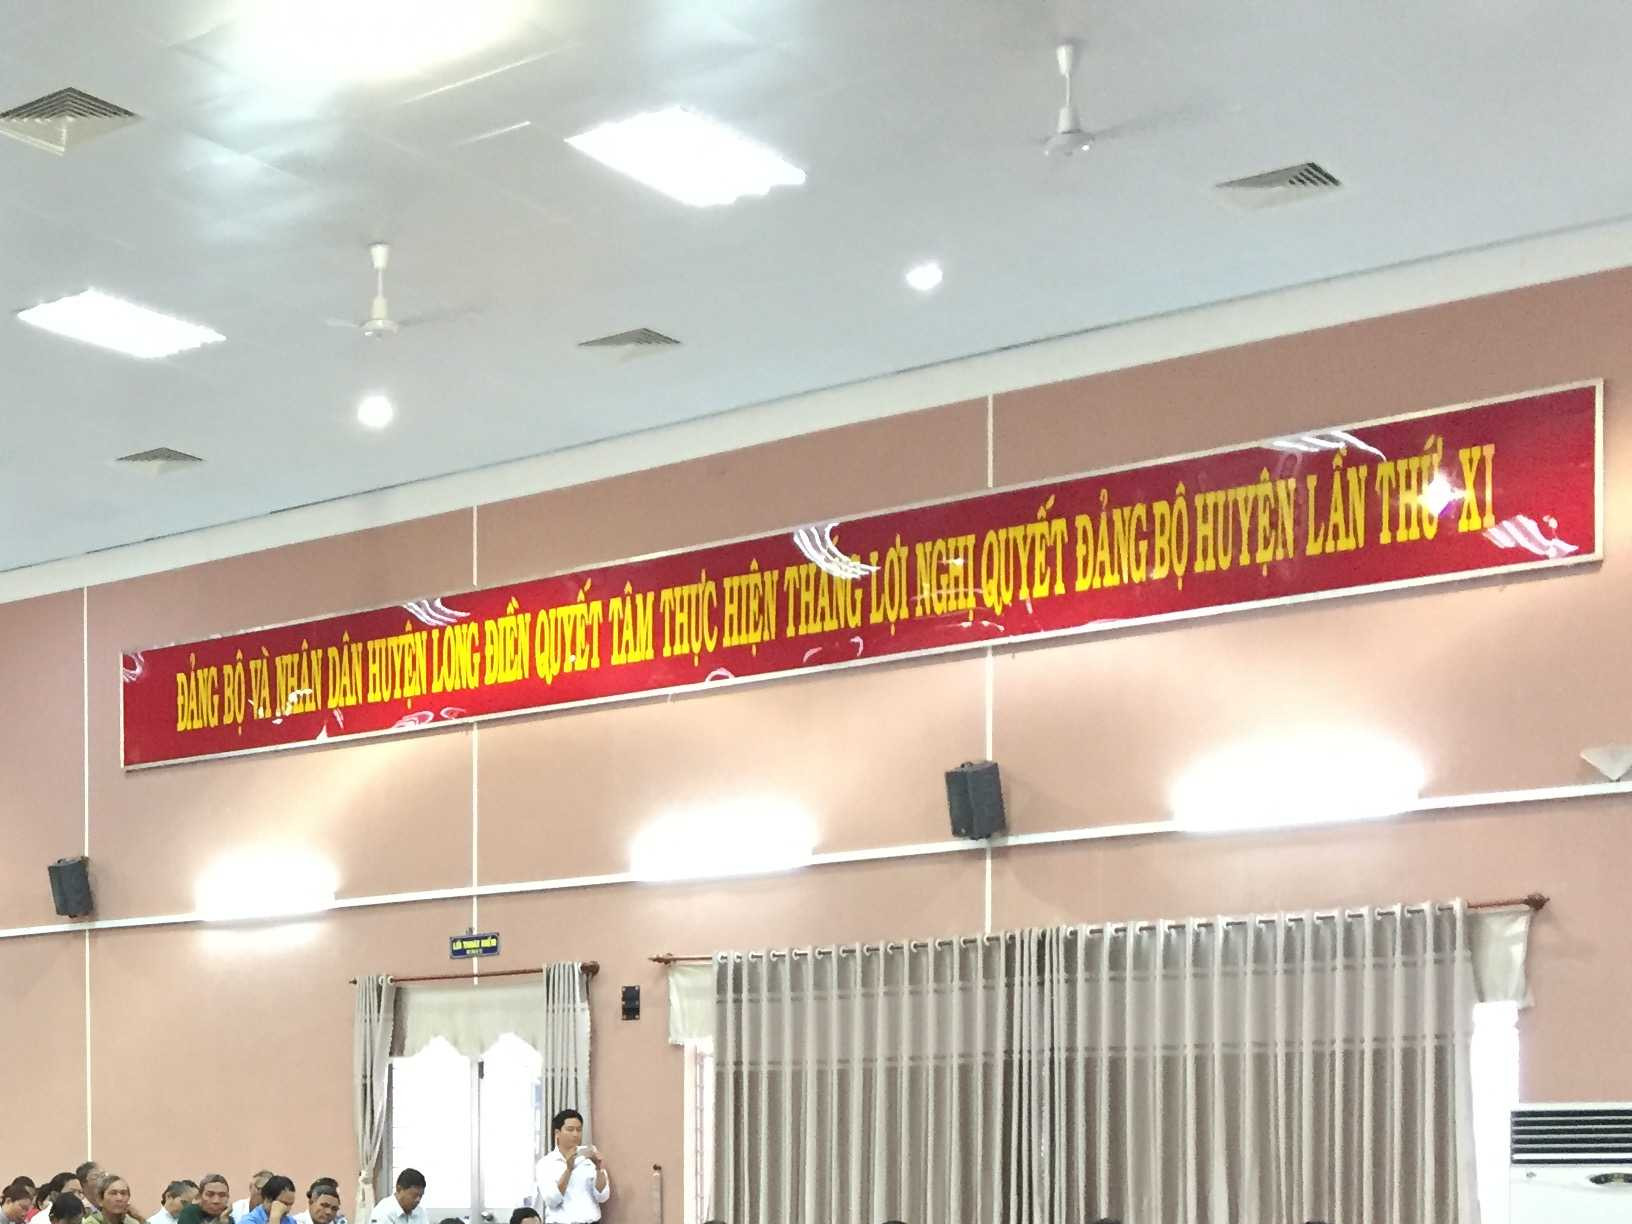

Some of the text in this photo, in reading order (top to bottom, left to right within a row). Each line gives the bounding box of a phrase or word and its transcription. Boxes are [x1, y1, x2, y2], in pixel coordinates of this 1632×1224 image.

[176, 652, 219, 731] ĐẢNG
[224, 649, 245, 735] BỘ
[276, 639, 323, 715] NHÂN
[328, 630, 362, 710] DÂN
[367, 619, 428, 709] HUYỆN
[432, 622, 481, 693] LONG
[484, 596, 531, 685] ĐIỀN
[534, 578, 603, 684] QUYẾT
[609, 580, 655, 666] TÂM
[660, 569, 717, 667] THỰC
[723, 558, 778, 656] HIỆN
[870, 533, 909, 636] LỢI
[915, 536, 976, 621] NGHỊ
[981, 494, 1067, 615] QUYẾT
[1075, 488, 1148, 593] ĐẢNG
[1152, 480, 1189, 590] BỘ
[1194, 466, 1296, 575] HUYỆN
[1307, 445, 1368, 556] LẦN
[1457, 443, 1494, 532] XI
